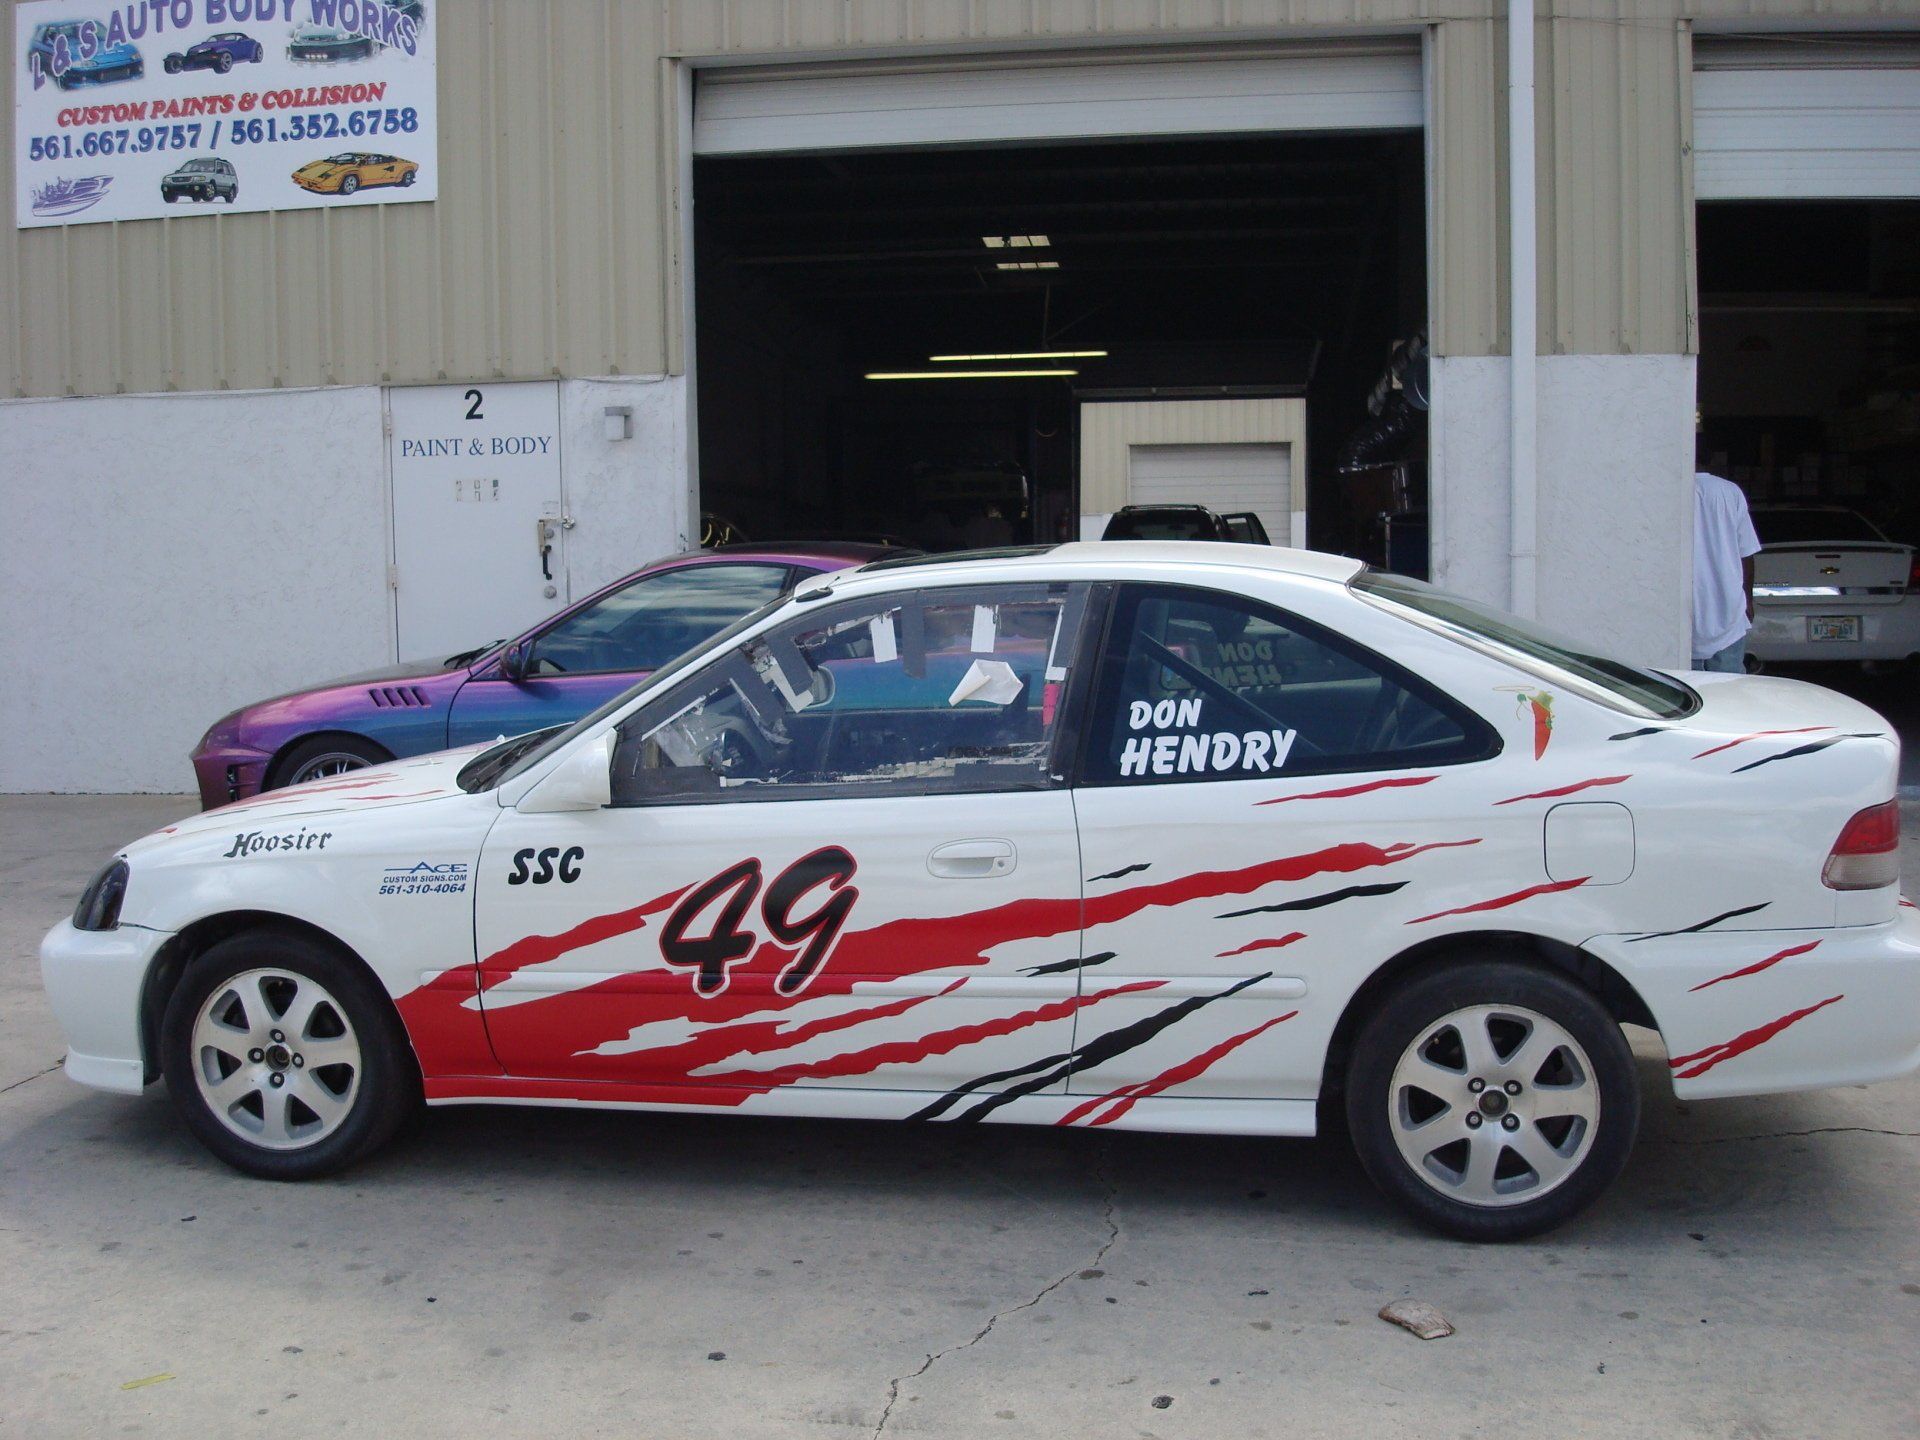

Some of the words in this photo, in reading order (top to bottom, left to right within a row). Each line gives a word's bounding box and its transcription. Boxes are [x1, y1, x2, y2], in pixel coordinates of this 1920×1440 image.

[32, 53, 46, 91] L
[52, 35, 72, 77] &
[79, 20, 98, 60] S
[105, 0, 193, 50] AUTO
[206, 0, 294, 24] BODY
[312, 0, 417, 56] WORKS
[57, 101, 149, 128] CUSTOM
[150, 94, 236, 120] PAINTS
[238, 92, 259, 112] &
[261, 82, 387, 110] COLLISION
[29, 122, 202, 162] 561.667.9757
[231, 107, 419, 145] 561.352.6758
[464, 389, 484, 420] 2
[402, 438, 462, 457] PAINT
[469, 439, 485, 456] &
[491, 436, 552, 455] BODY
[1129, 698, 1202, 730] DON
[1119, 729, 1297, 776] HENDRY
[223, 826, 333, 859] Hoosier
[420, 874, 467, 882] SIGNS.COM
[508, 845, 585, 886] SSC
[379, 883, 466, 895] 561-310-4064
[659, 845, 860, 994] 49
